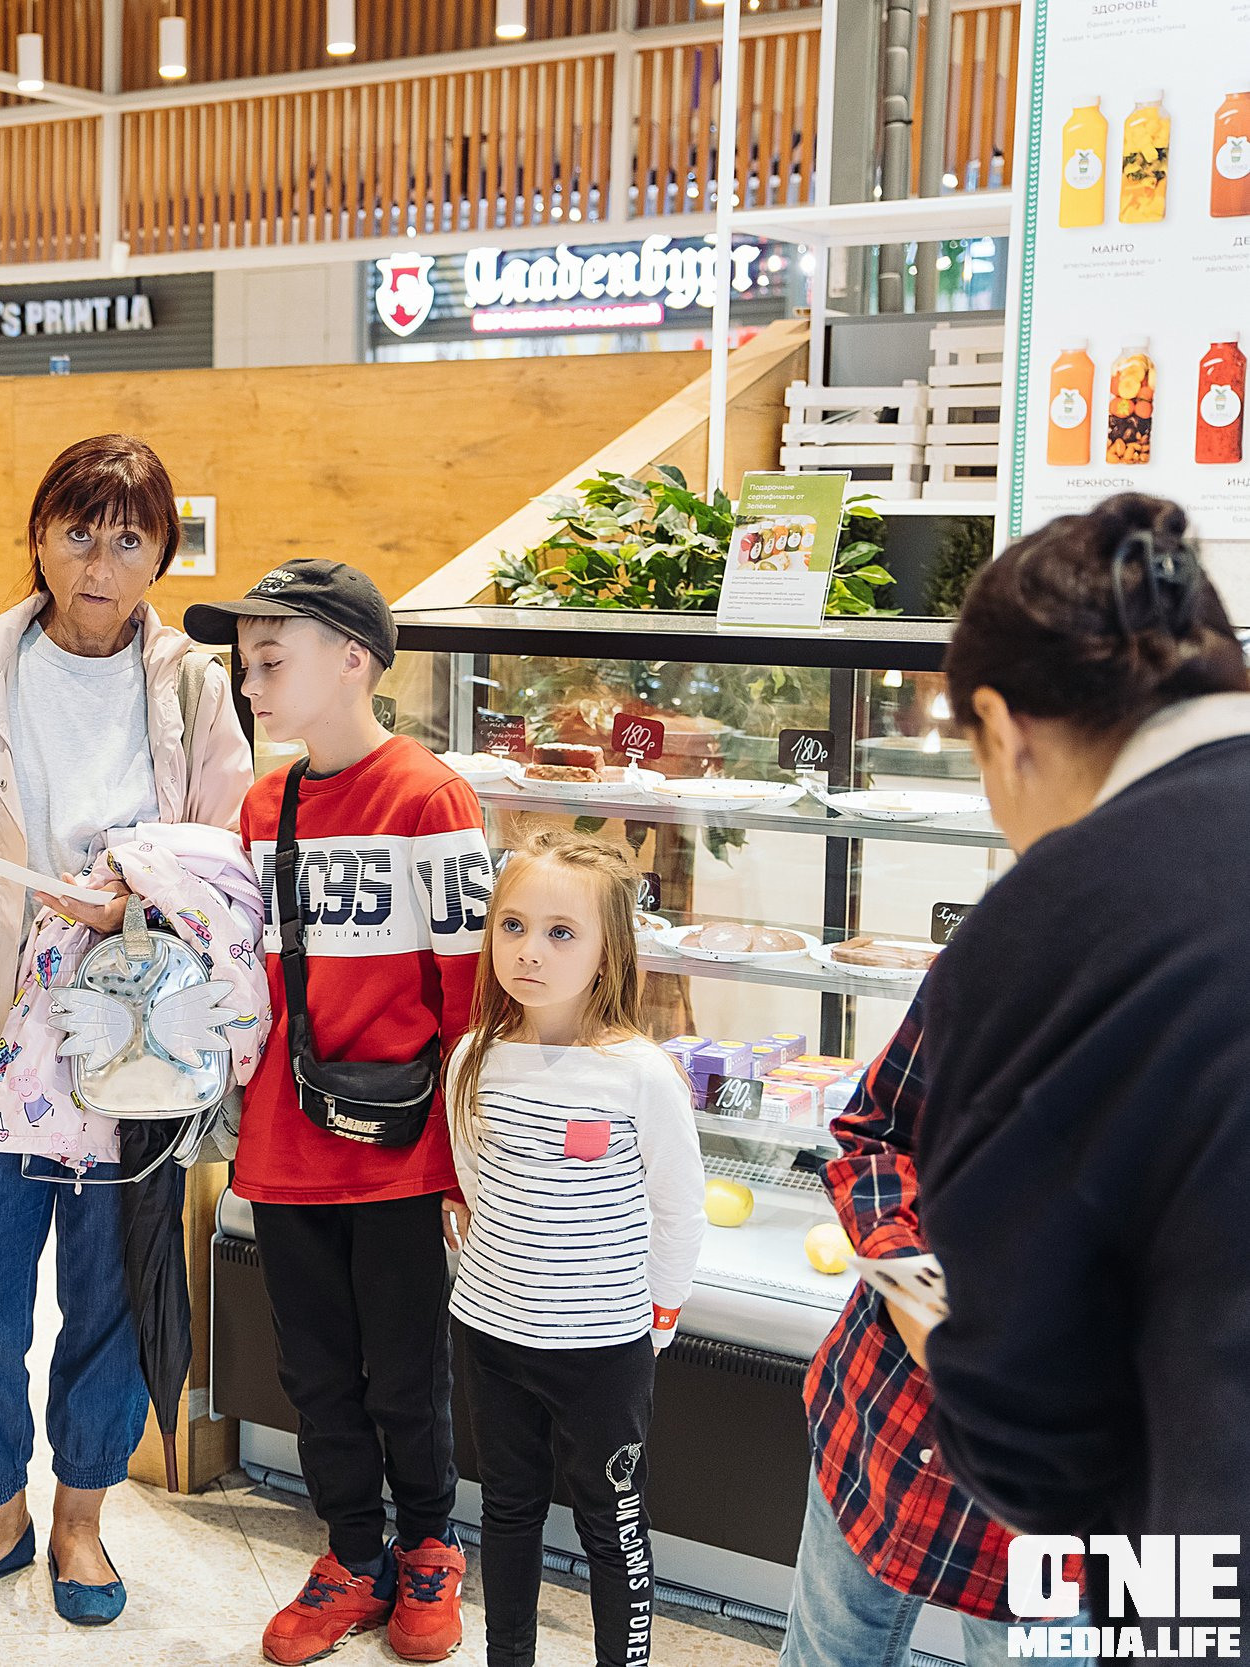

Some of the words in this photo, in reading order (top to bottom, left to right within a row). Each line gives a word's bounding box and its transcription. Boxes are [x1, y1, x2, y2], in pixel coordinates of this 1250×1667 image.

[1092, 0, 1158, 15] ЗДОРОВЬЕ
[1092, 243, 1135, 254] МАНГО
[25, 297, 111, 336] PRINT
[115, 295, 153, 331] LA
[1067, 479, 1135, 487] НЕЖНОСТЬ
[336, 929, 391, 938] LIMITS
[615, 1493, 650, 1591] UNICORNS
